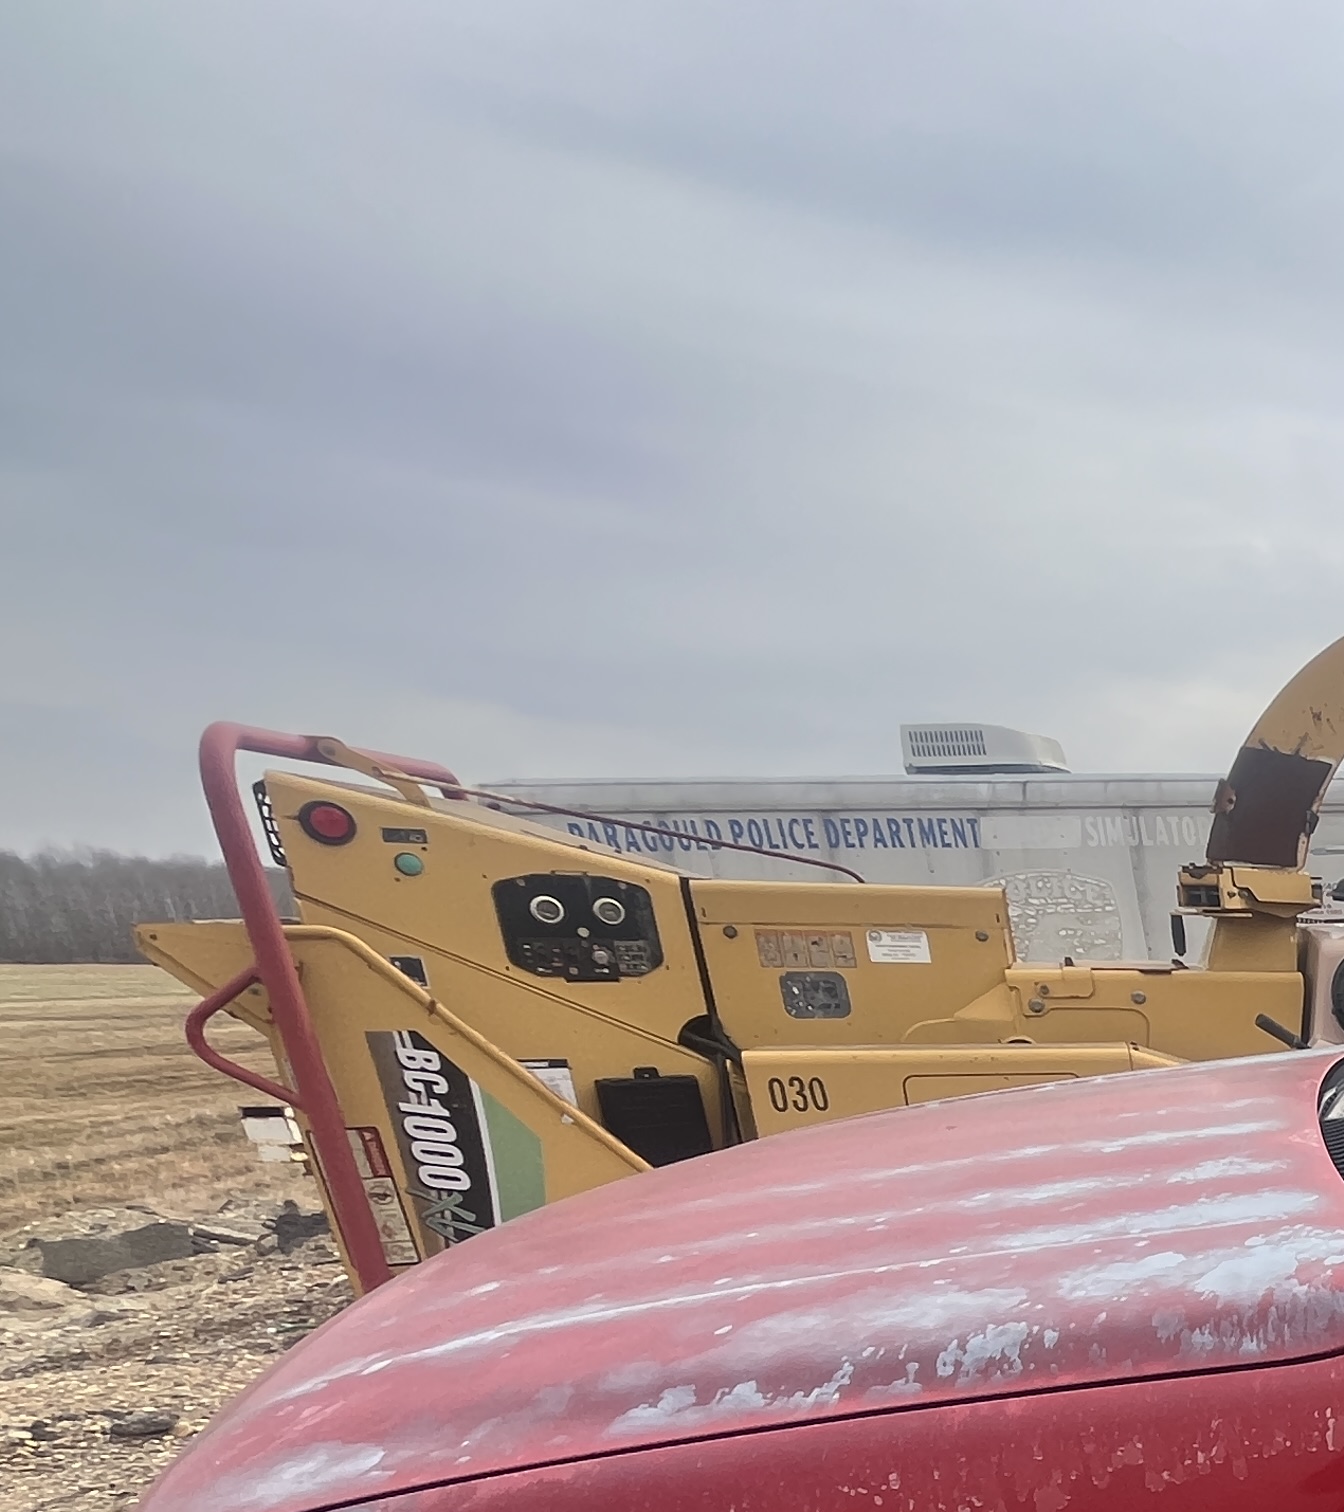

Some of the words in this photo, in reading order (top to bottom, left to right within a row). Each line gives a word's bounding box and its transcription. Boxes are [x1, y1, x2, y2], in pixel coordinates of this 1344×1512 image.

[727, 818, 820, 850] POLICE
[823, 817, 981, 849] DEPARTMENT
[767, 1076, 829, 1112] 030
[396, 1047, 472, 1192] BC-1000
